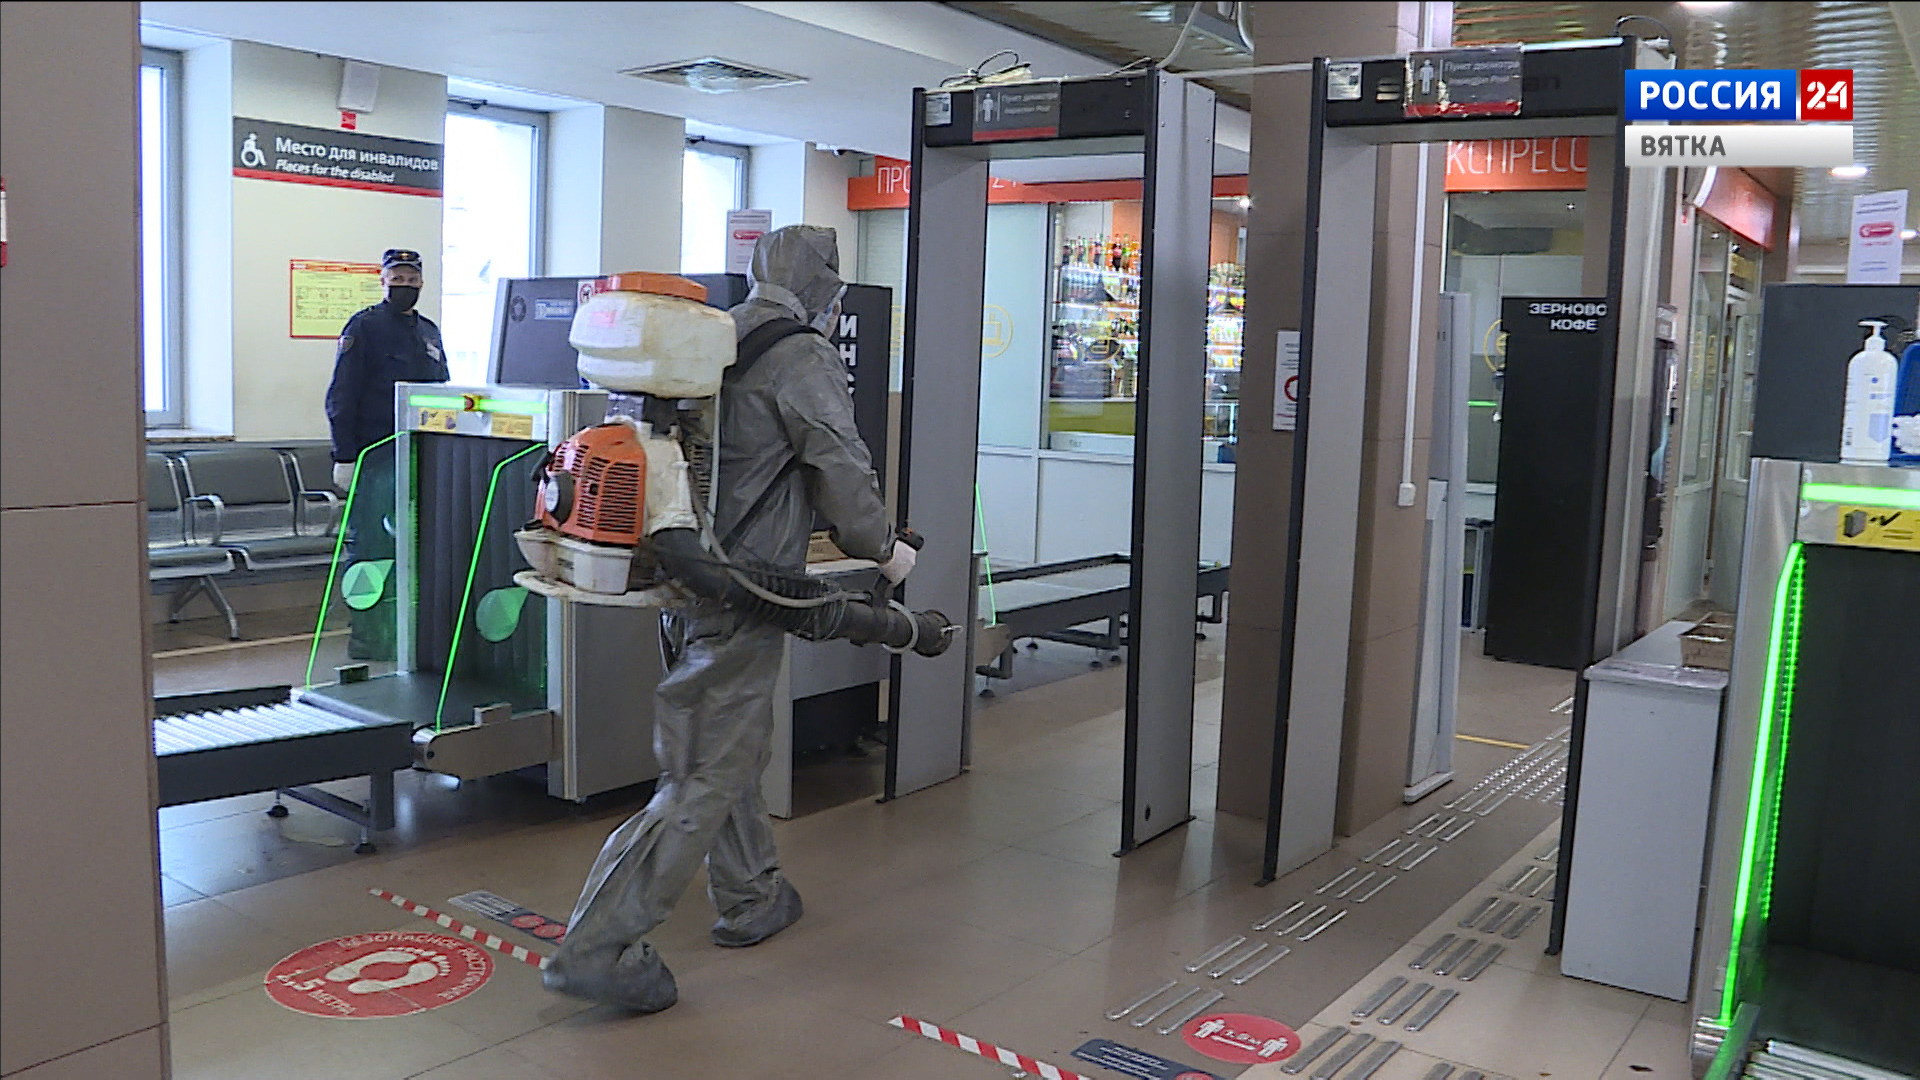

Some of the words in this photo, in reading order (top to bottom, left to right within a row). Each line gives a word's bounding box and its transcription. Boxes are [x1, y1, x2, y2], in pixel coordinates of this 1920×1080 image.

[275, 137, 326, 157] Место
[328, 147, 356, 161] для
[359, 150, 439, 171] инвалидов
[275, 159, 310, 175] Places
[312, 163, 327, 176] for
[329, 165, 350, 178] the
[350, 168, 395, 183] disabled
[1550, 319, 1599, 331] КОФЕ
